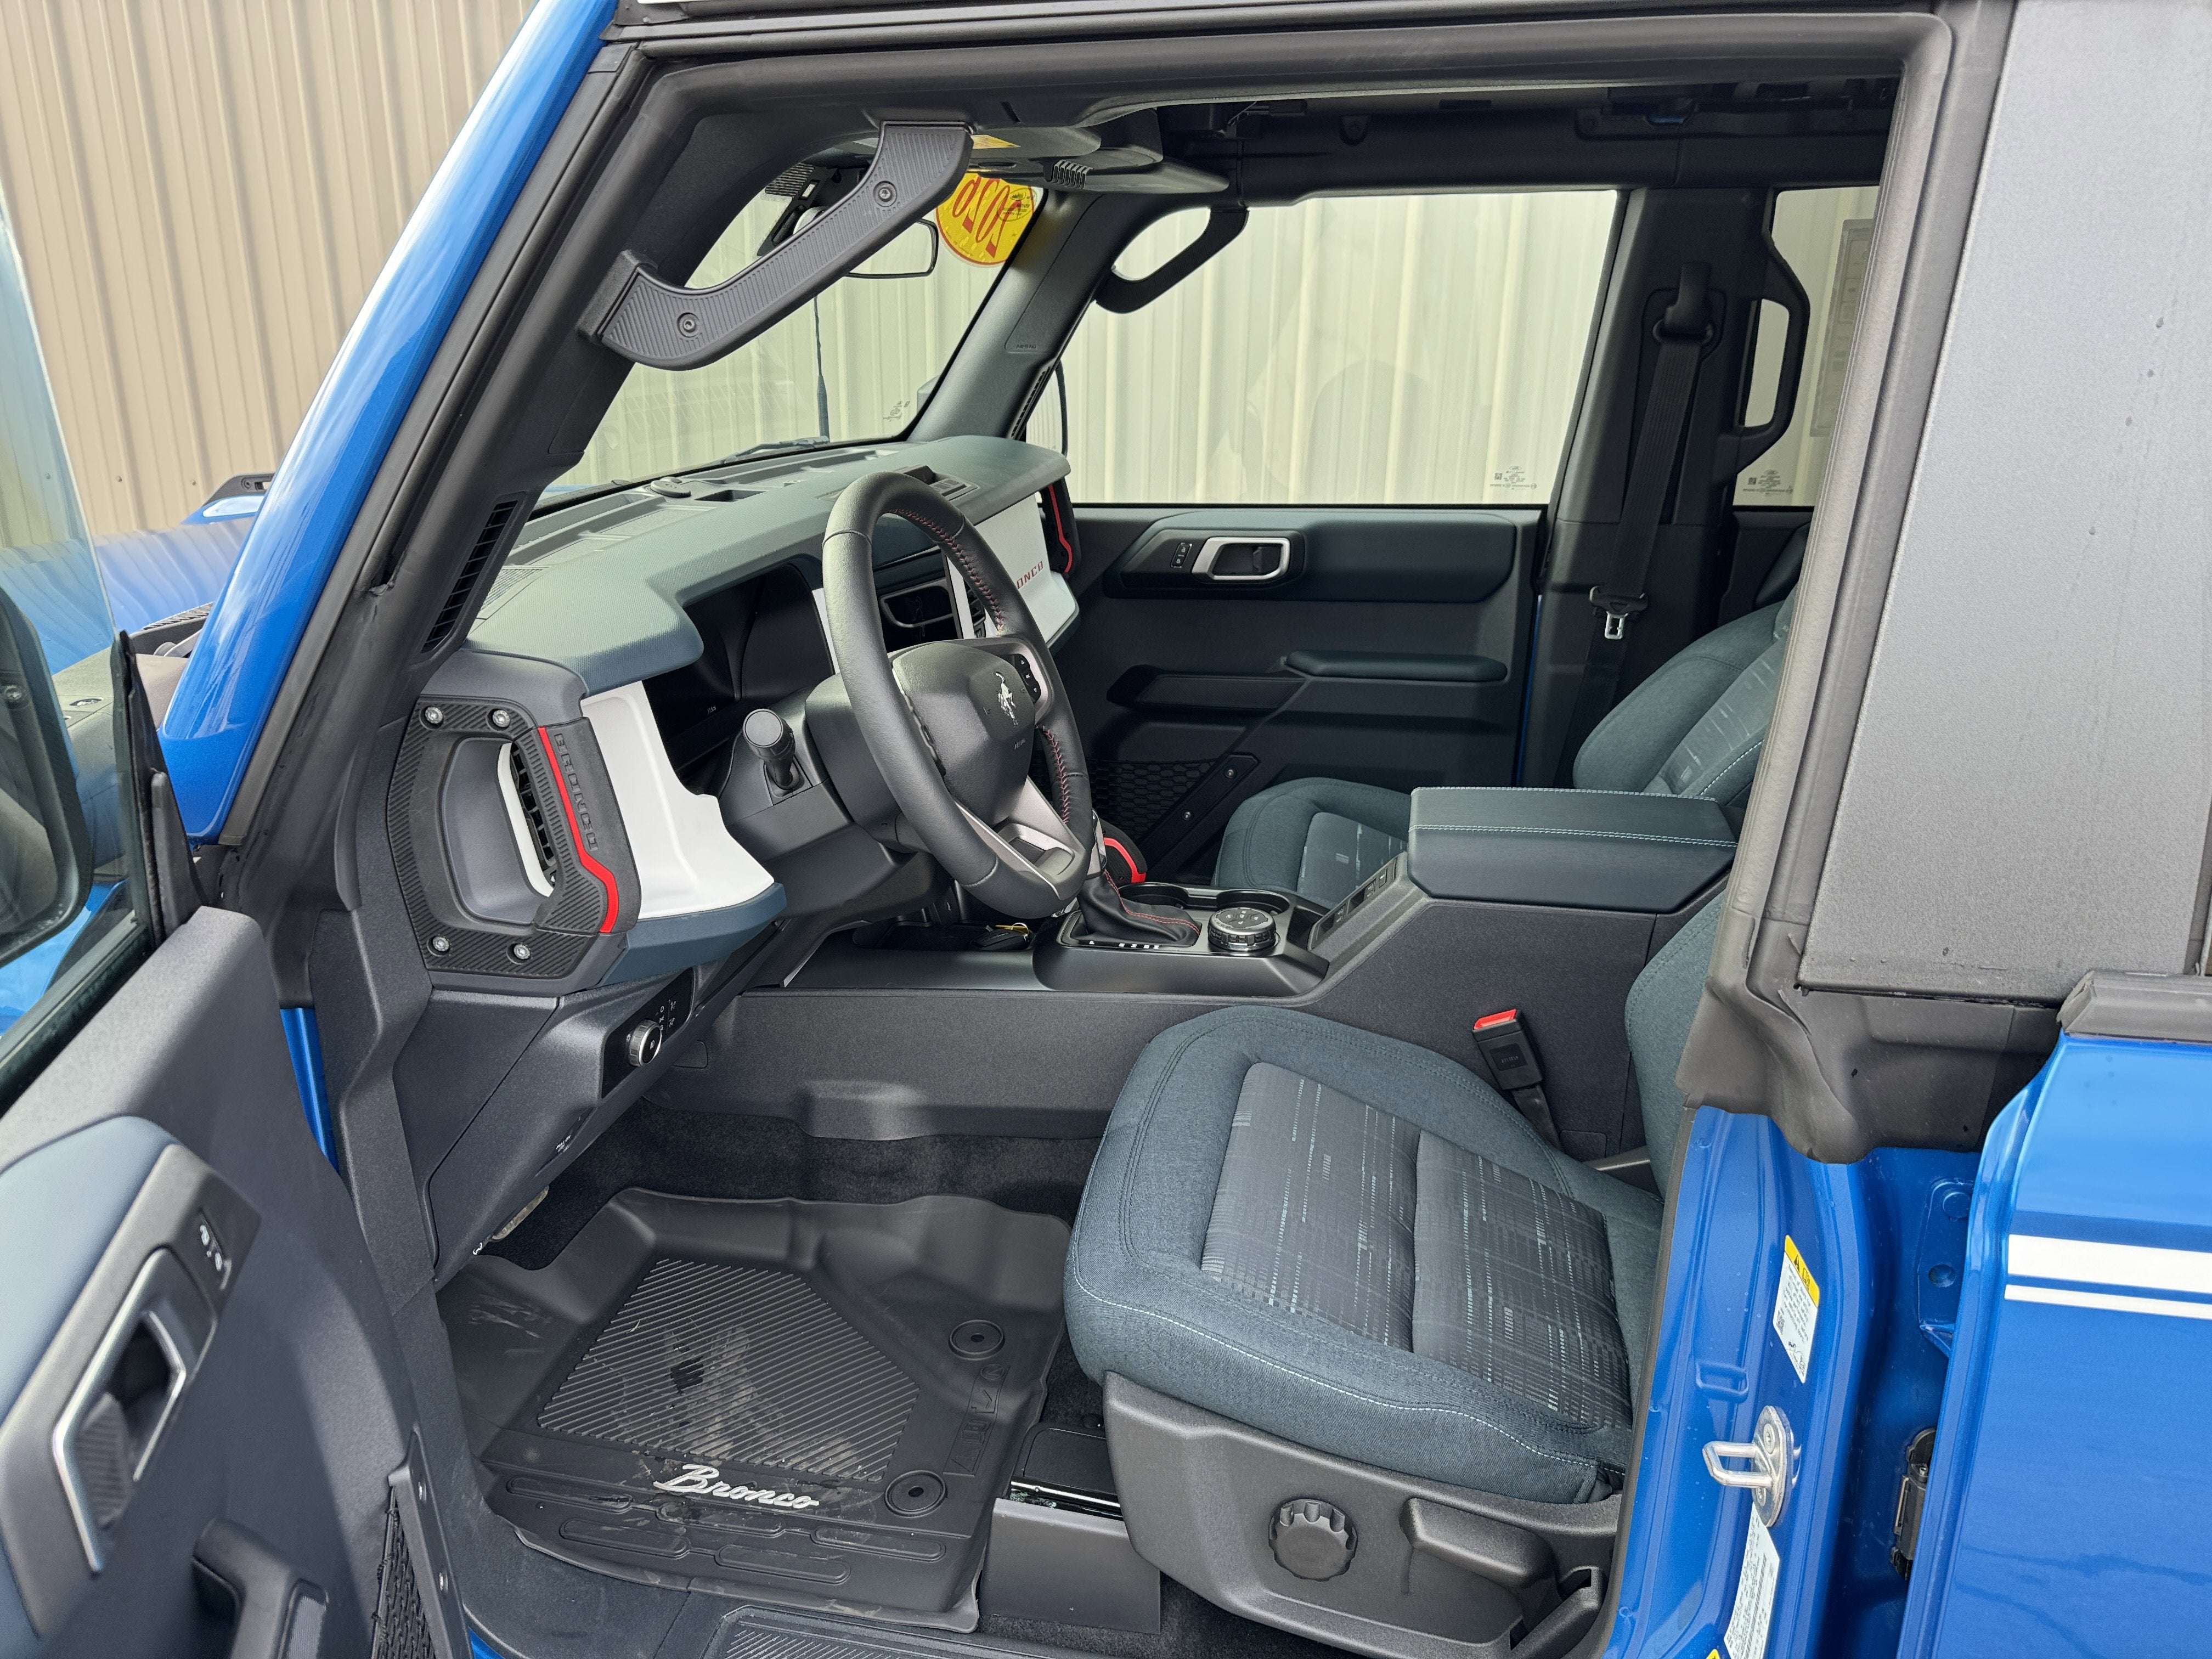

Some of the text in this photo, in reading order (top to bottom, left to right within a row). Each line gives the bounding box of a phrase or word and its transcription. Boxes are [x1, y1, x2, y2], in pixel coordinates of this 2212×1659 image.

[1016, 561, 1043, 589] ONCO
[554, 733, 598, 851] BRONCO
[653, 1464, 820, 1509] Bronco
